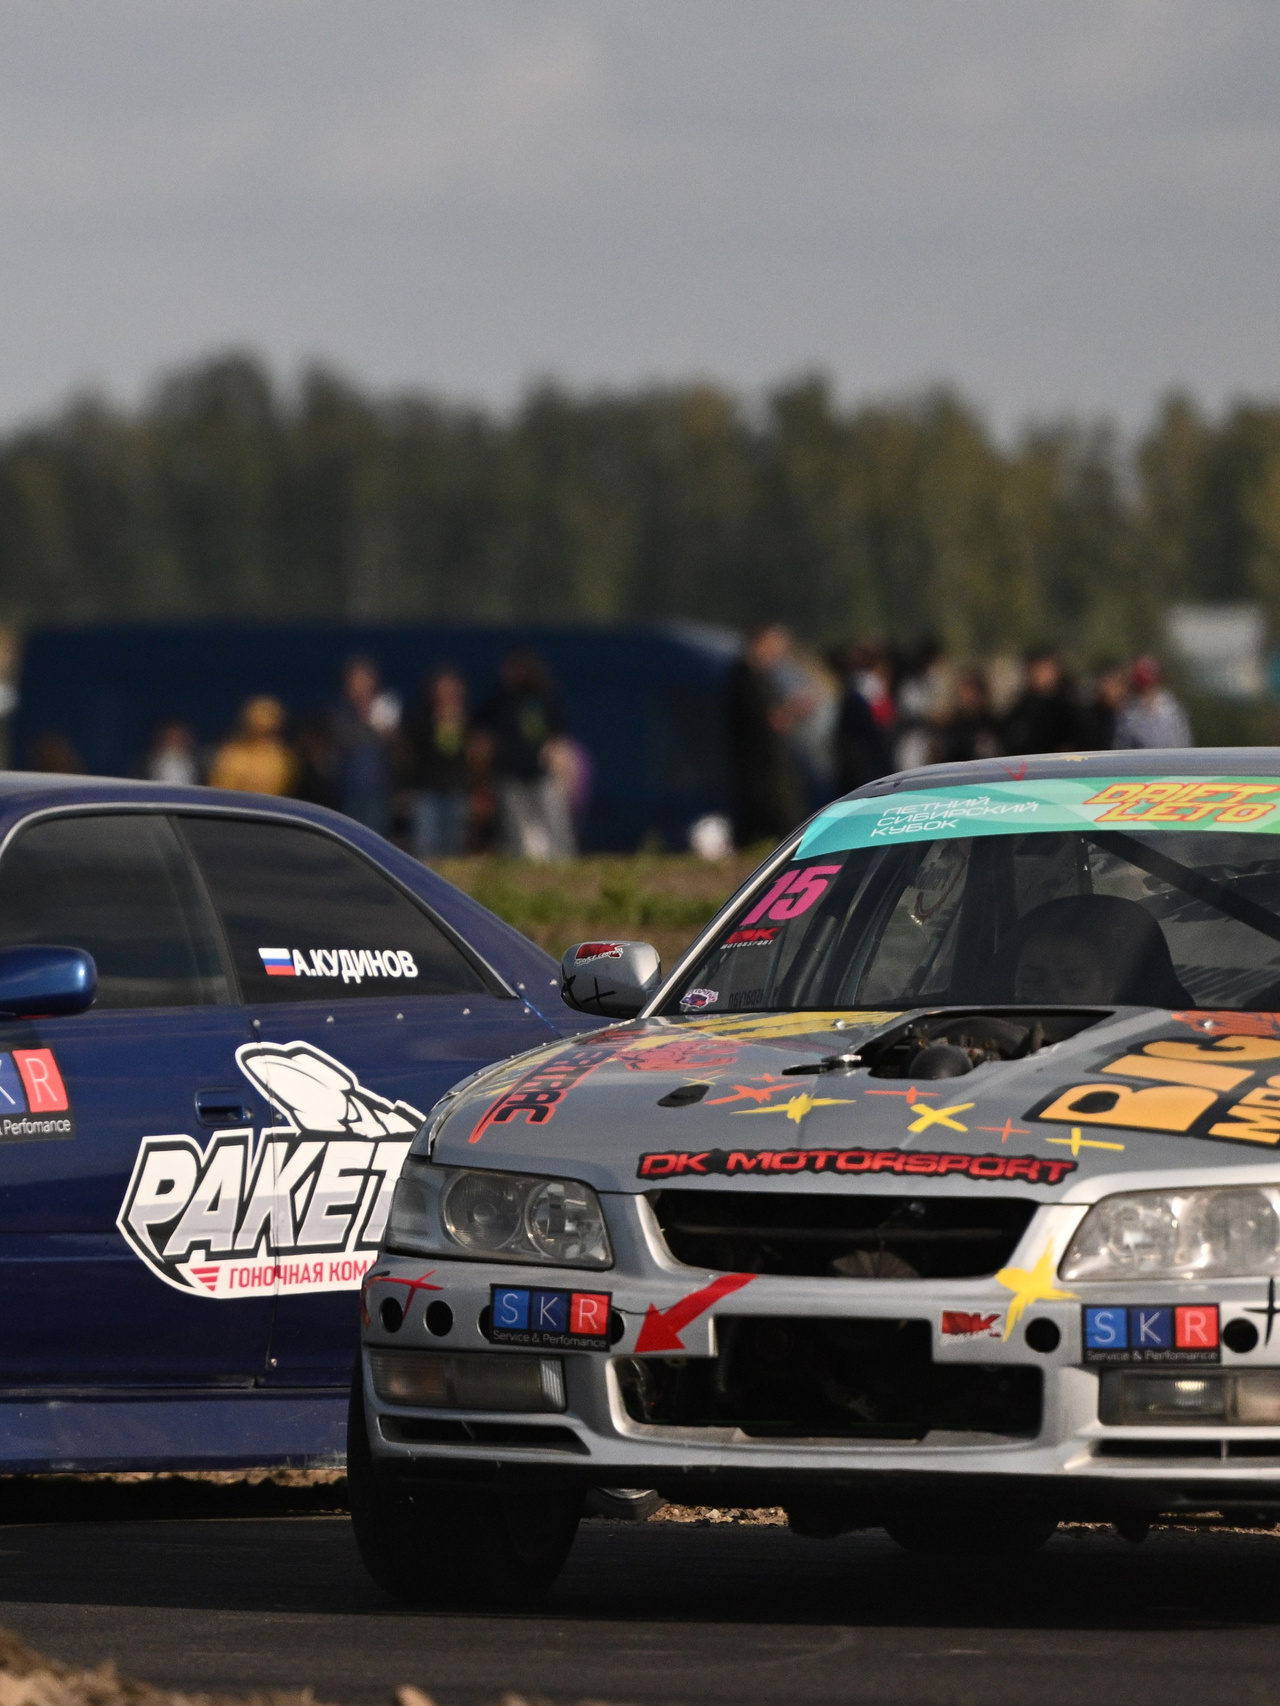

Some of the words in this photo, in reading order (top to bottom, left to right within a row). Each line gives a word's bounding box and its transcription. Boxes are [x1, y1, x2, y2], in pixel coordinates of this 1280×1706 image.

[883, 796, 991, 817] ЛЕТНИЙ
[1082, 782, 1280, 805] DRIFT
[876, 801, 1039, 827] СИБИРСКИЙ
[1094, 801, 1277, 823] LETO
[871, 818, 960, 838] КУБОК
[739, 864, 843, 927] 15
[291, 948, 419, 984] А.КУДИНОВ
[640, 1152, 709, 1174] DK
[725, 1150, 1075, 1183] MOTORSPORT
[229, 1261, 324, 1289] ГОНОЧНАЯ
[329, 1259, 376, 1281] КОМ
[500, 1292, 599, 1331] SKR
[492, 1329, 531, 1343] Service
[531, 1332, 540, 1343] &
[1093, 1310, 1209, 1345] SKR
[1086, 1350, 1130, 1361] Service
